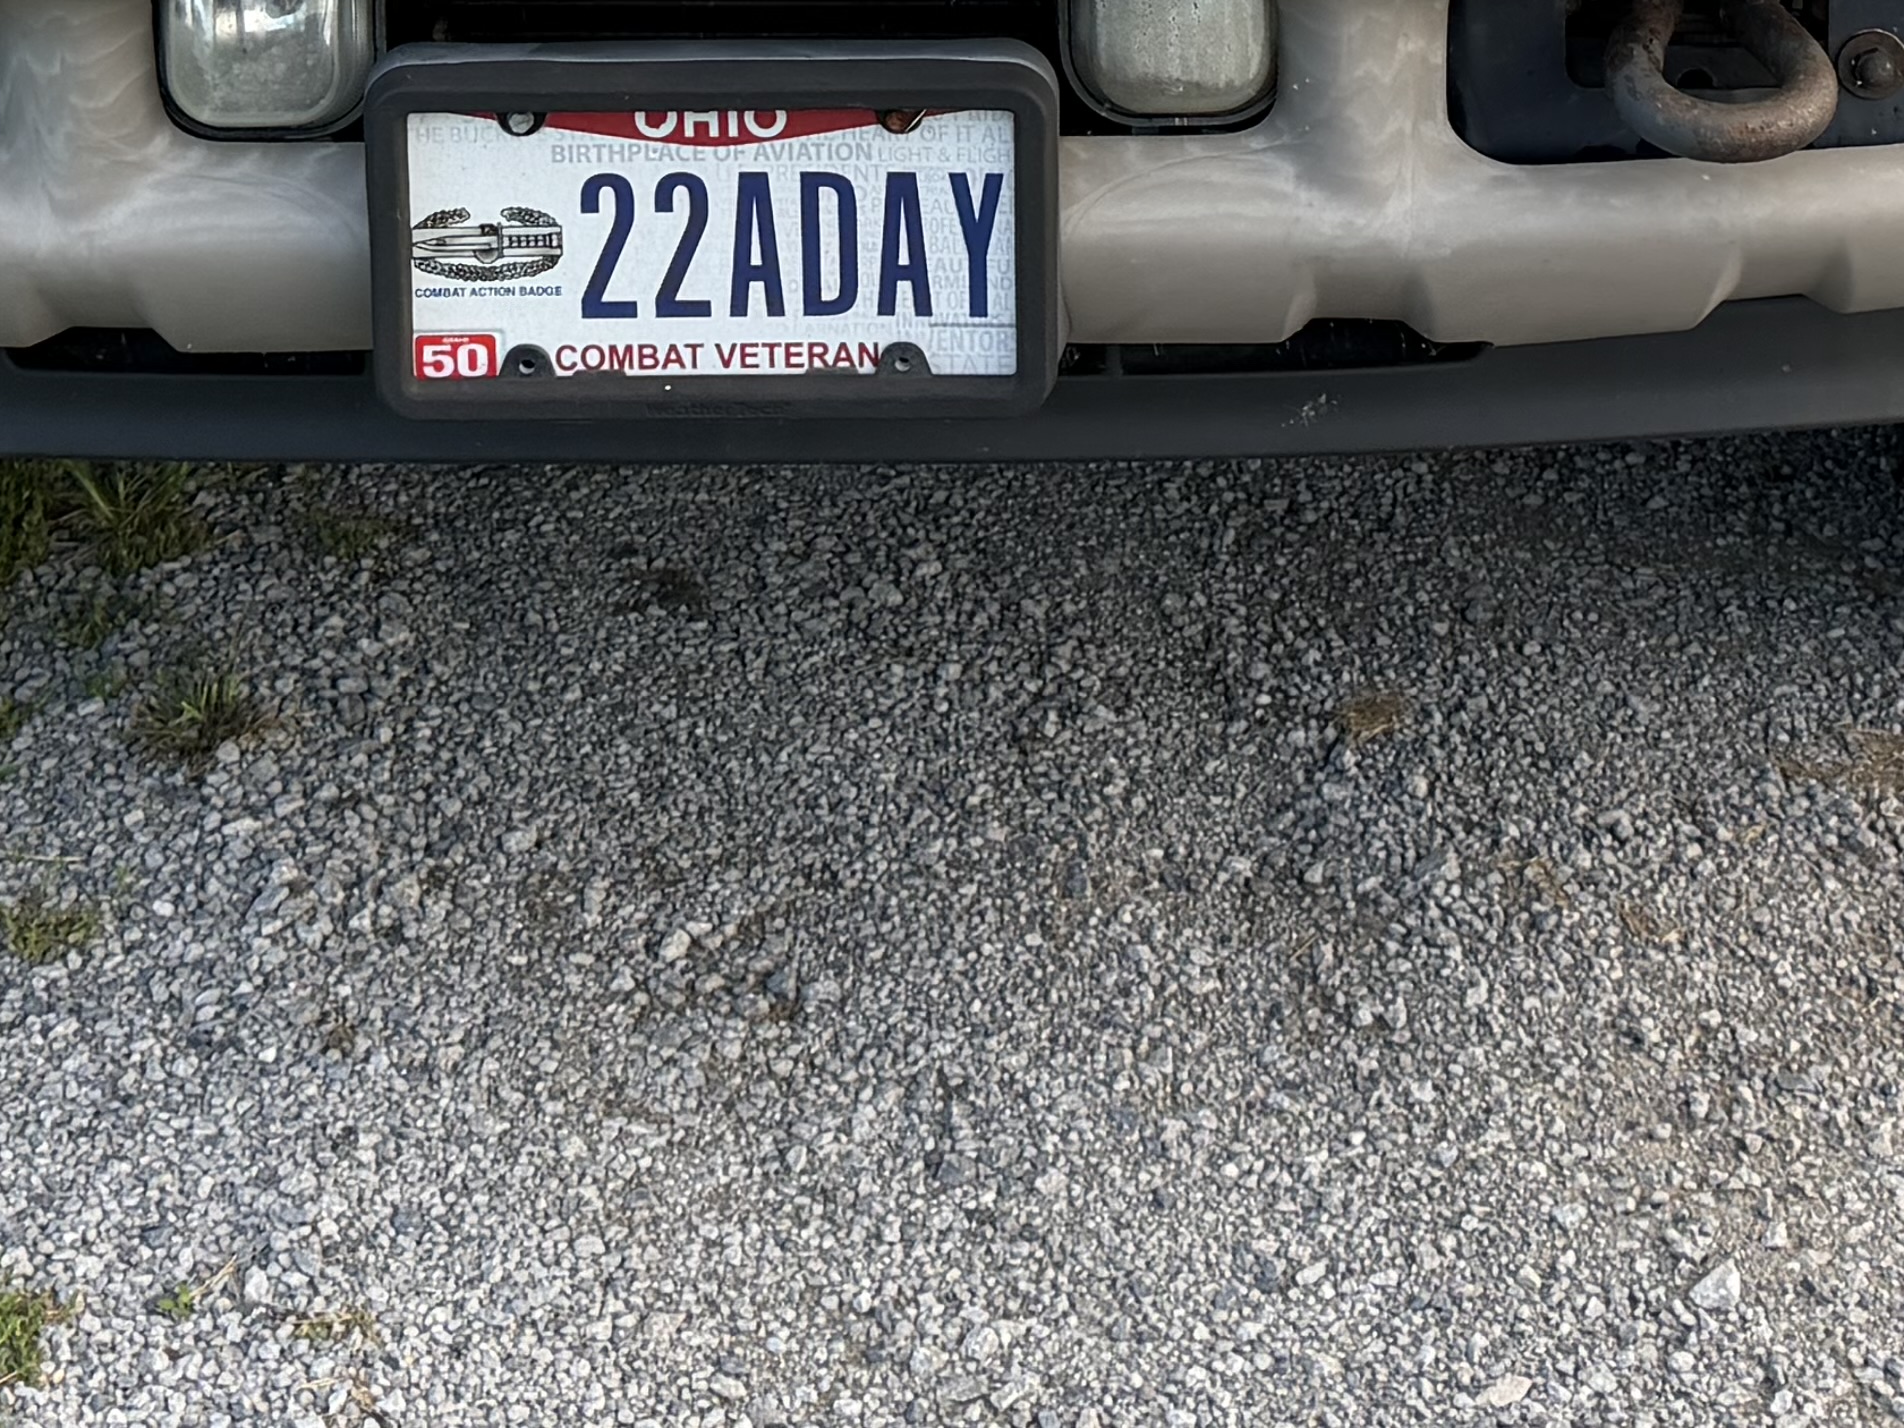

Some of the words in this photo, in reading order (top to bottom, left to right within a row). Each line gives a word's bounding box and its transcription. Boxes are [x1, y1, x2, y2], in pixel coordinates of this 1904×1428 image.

[633, 110, 787, 138] OHIO
[551, 142, 706, 164] BIRTHPLACE
[712, 142, 747, 163] OF
[753, 141, 874, 163] AVIATION
[580, 171, 1005, 319] 22ADAY
[415, 286, 467, 299] COMBAT
[469, 285, 516, 298] ACTION
[519, 285, 564, 297] BADGE
[422, 344, 489, 378] 50
[555, 344, 705, 372] COMBAT
[718, 341, 881, 370] VETERAN
